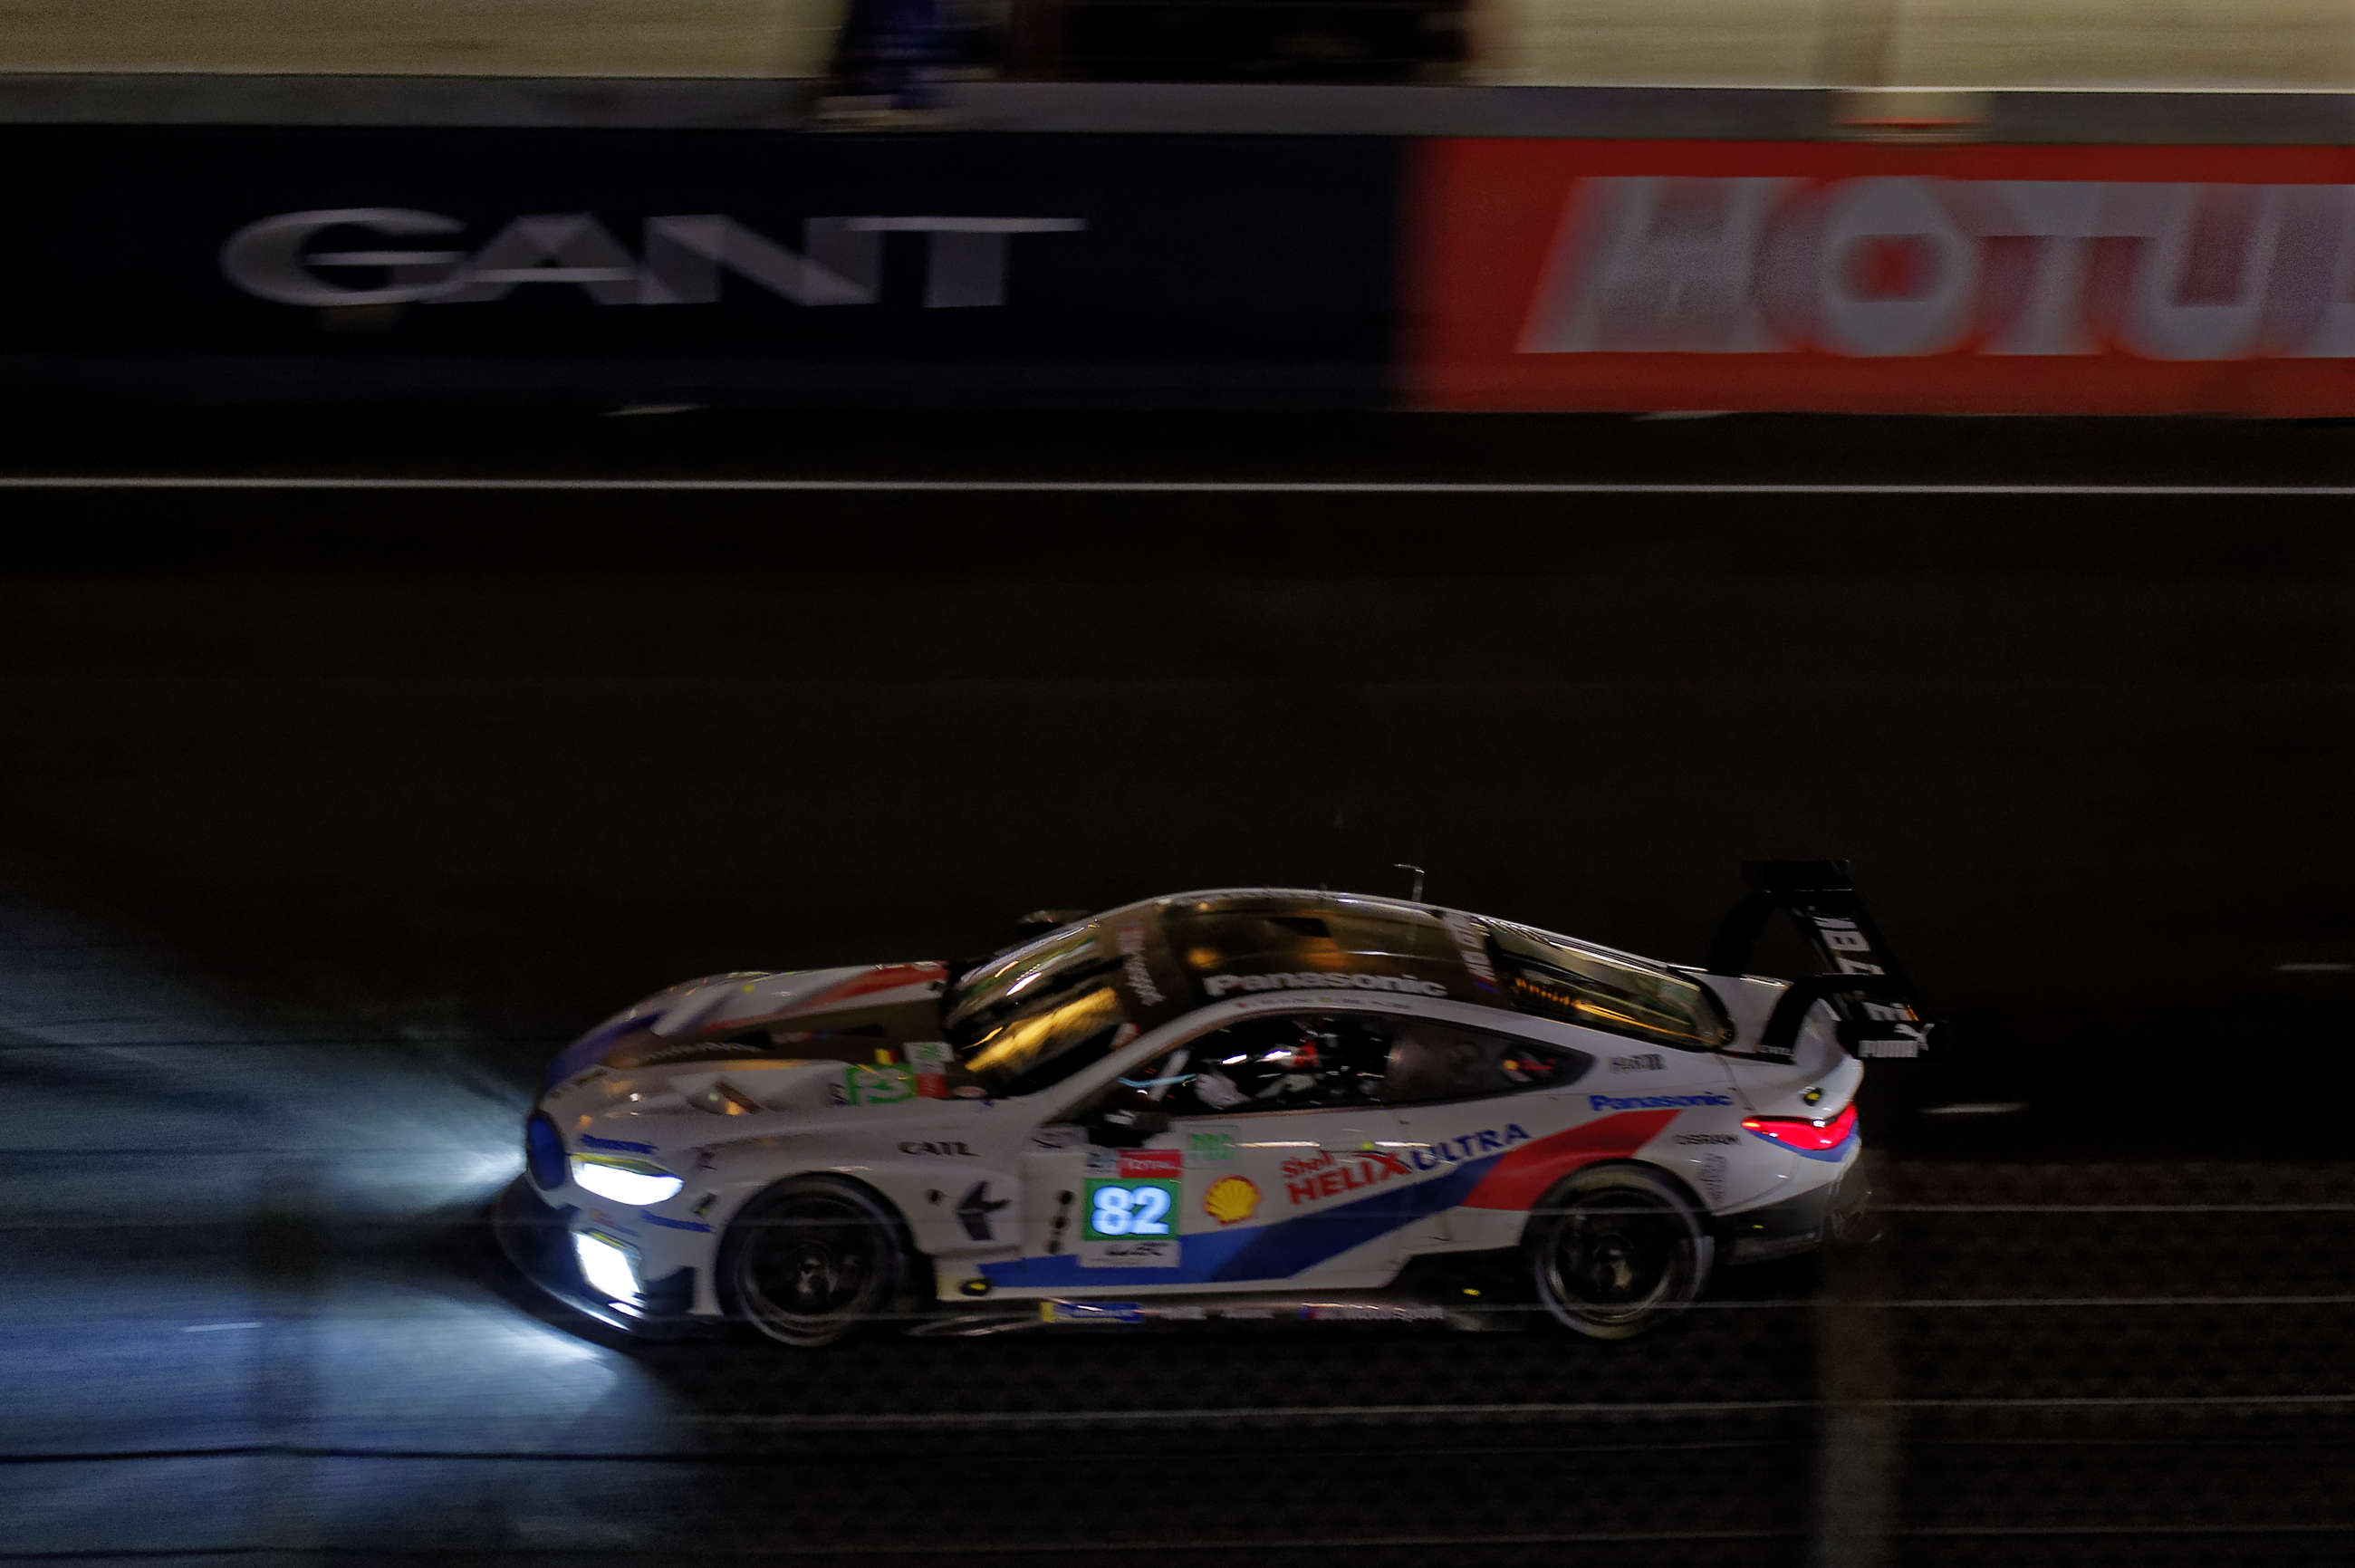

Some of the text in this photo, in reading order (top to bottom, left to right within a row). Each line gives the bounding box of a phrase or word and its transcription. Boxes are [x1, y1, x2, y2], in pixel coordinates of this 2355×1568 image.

[220, 206, 1087, 308] GANT
[1514, 175, 2355, 362] MOTU
[1204, 972, 1448, 997] Panasonic
[1589, 1092, 1734, 1111] Panasonic
[1284, 1122, 1530, 1206] HELIX ULTRA
[1090, 1184, 1172, 1236] 82
